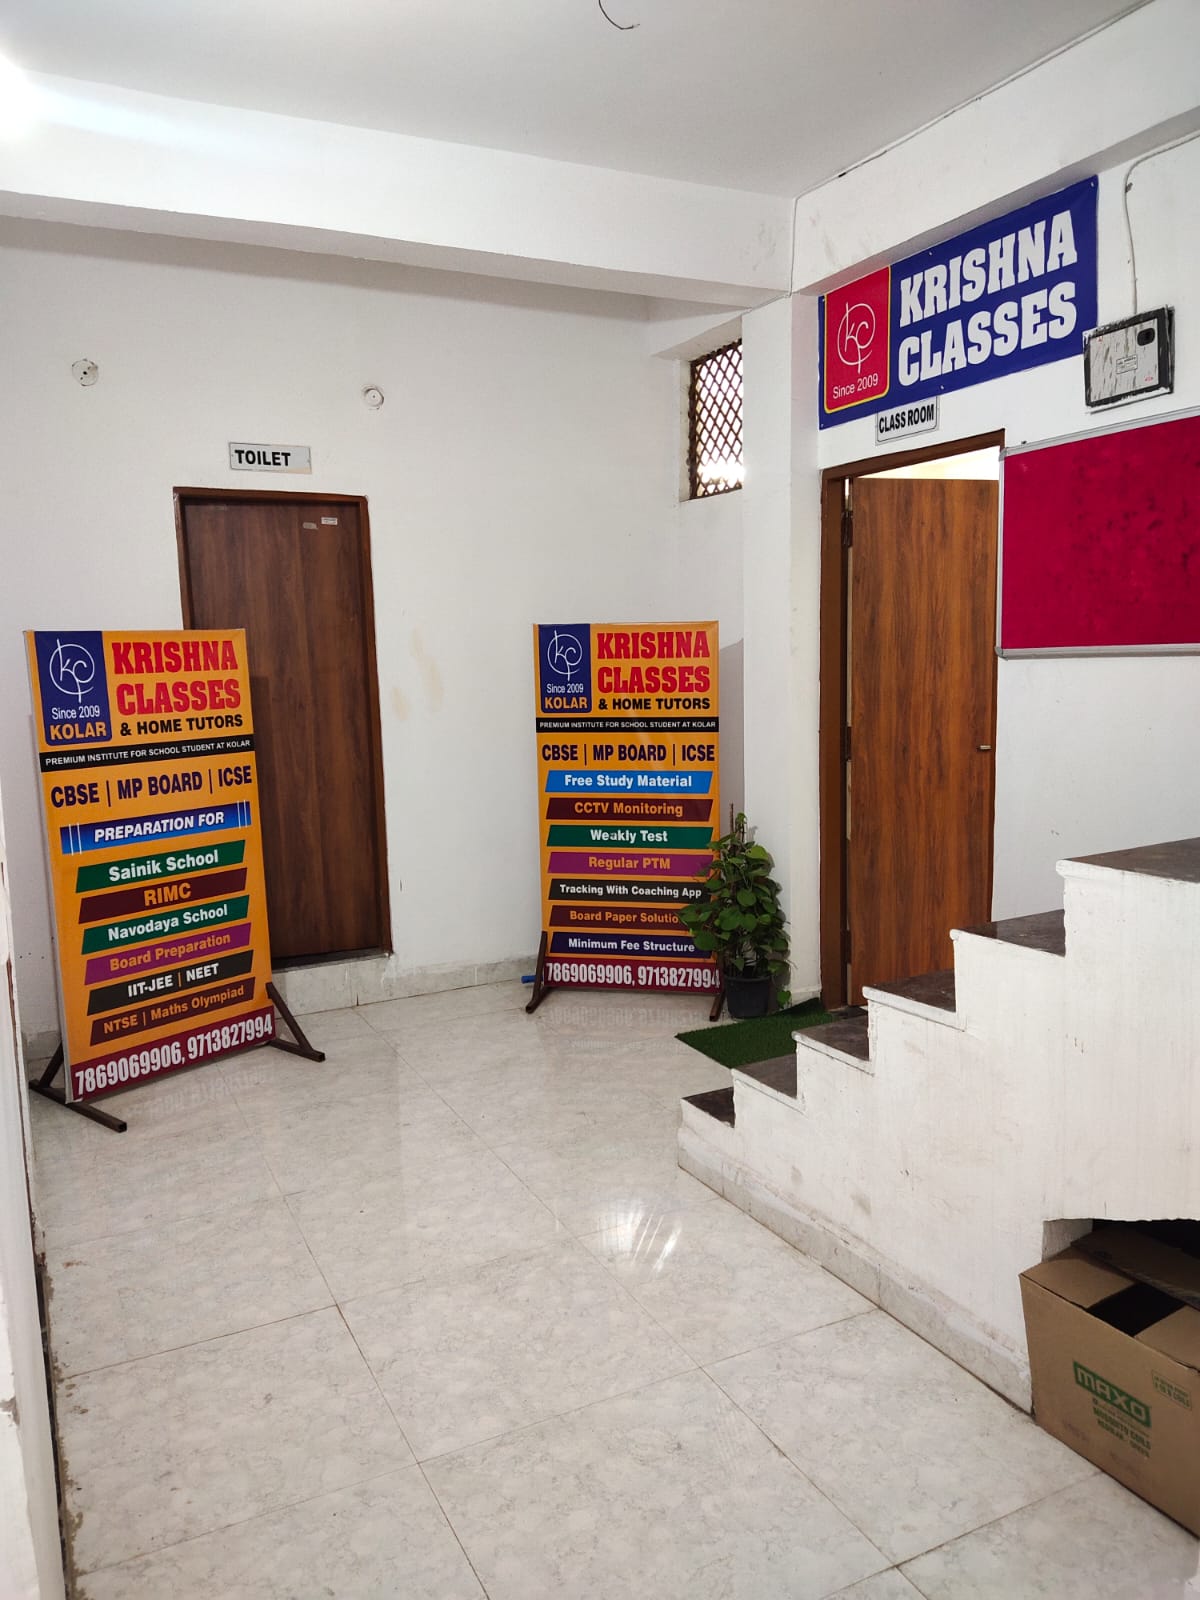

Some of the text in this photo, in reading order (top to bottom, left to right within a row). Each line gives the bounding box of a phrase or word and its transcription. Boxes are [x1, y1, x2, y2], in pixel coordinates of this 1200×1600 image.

[900, 210, 1078, 328] KRISHNA
[898, 281, 1077, 387] CLASSES
[832, 373, 879, 399] Since 2009
[879, 404, 934, 433] CLASS ROOM
[234, 449, 291, 467] TOILET
[111, 640, 238, 675] KRISHNA
[596, 631, 710, 659] KRISHNA
[546, 683, 584, 693] Since 2009
[597, 666, 710, 693] CLASSES
[116, 679, 241, 715] CLASSES
[544, 696, 588, 709] KOLAR
[598, 697, 710, 710] & HOME TUTORS
[51, 704, 101, 720] Since 2009
[50, 721, 107, 740] KOLAR
[120, 714, 243, 737] & HOME TUTORS
[45, 739, 250, 766] PREMIUM INSTITUTE FOR SCHOOL STUDENT AT KOLAR
[542, 744, 715, 762] CBSE MP BOARD ICSE
[50, 765, 252, 808] CBSE MP BOARD ICSE
[564, 774, 692, 789] Free Study Material
[574, 802, 684, 818] CCTV Monitoring
[94, 812, 225, 843] PREPARATION FOR
[590, 829, 668, 844] Weakly Test
[108, 850, 219, 882] Sainik School
[588, 856, 671, 870] Regular PTM
[143, 882, 192, 907] RIMC
[559, 884, 702, 899] Tracking With Coaching App
[107, 904, 228, 942] Navodaya School
[569, 910, 602, 921] Board
[605, 911, 637, 923] Paper
[109, 932, 231, 972] Board Preparation
[568, 937, 695, 953] Minimum Fee Structure
[127, 963, 219, 997] IIT-JEE NEET
[103, 984, 244, 1035] NTSE Maths Olympiad
[75, 1013, 273, 1096] 7869069906, 9713827994
